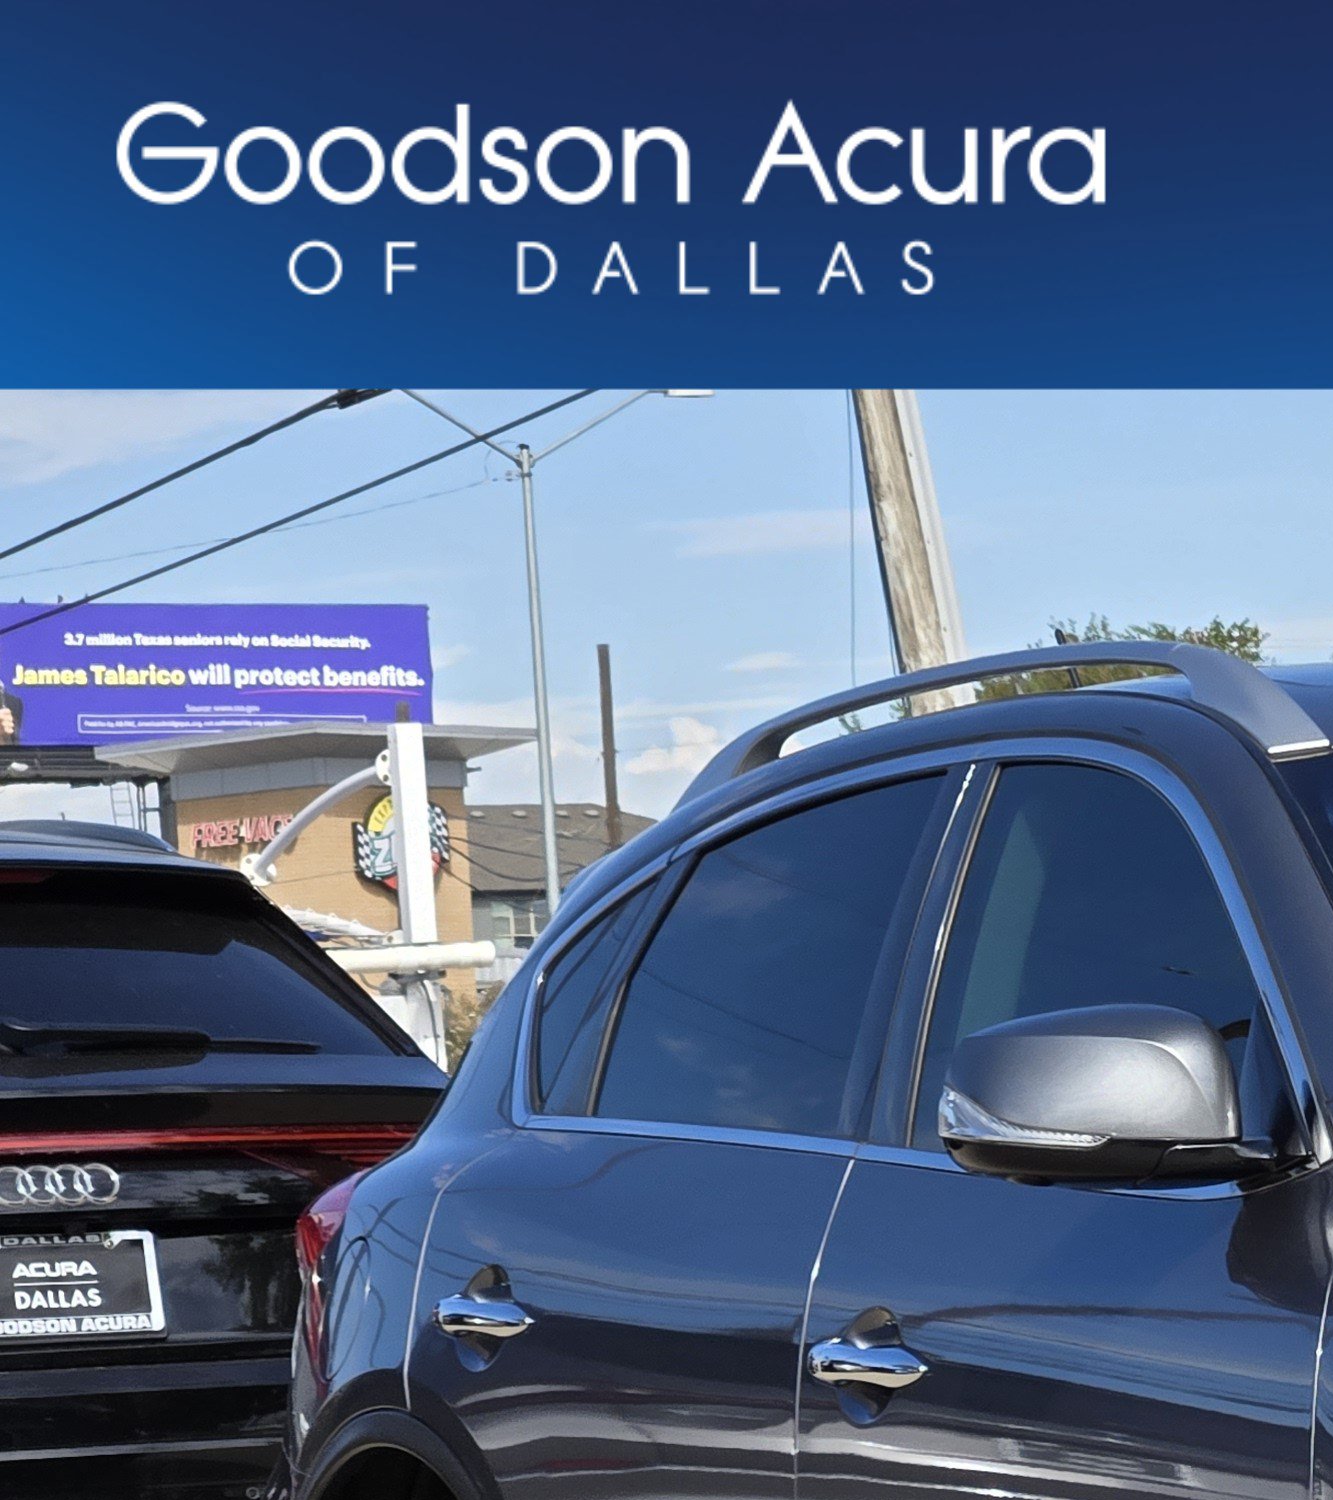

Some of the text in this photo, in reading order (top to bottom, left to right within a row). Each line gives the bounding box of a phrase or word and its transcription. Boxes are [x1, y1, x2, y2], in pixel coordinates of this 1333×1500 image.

[64, 632, 371, 650] 3.7 million Texas seniors rely on Social Security.
[12, 663, 425, 689] James Talarico will protect benefits.
[192, 819, 239, 848] FREE
[3, 1235, 100, 1247] DALLAS
[12, 1260, 97, 1278] ACURA
[14, 1288, 102, 1310] DALLAS
[81, 1314, 152, 1332] ACURA
